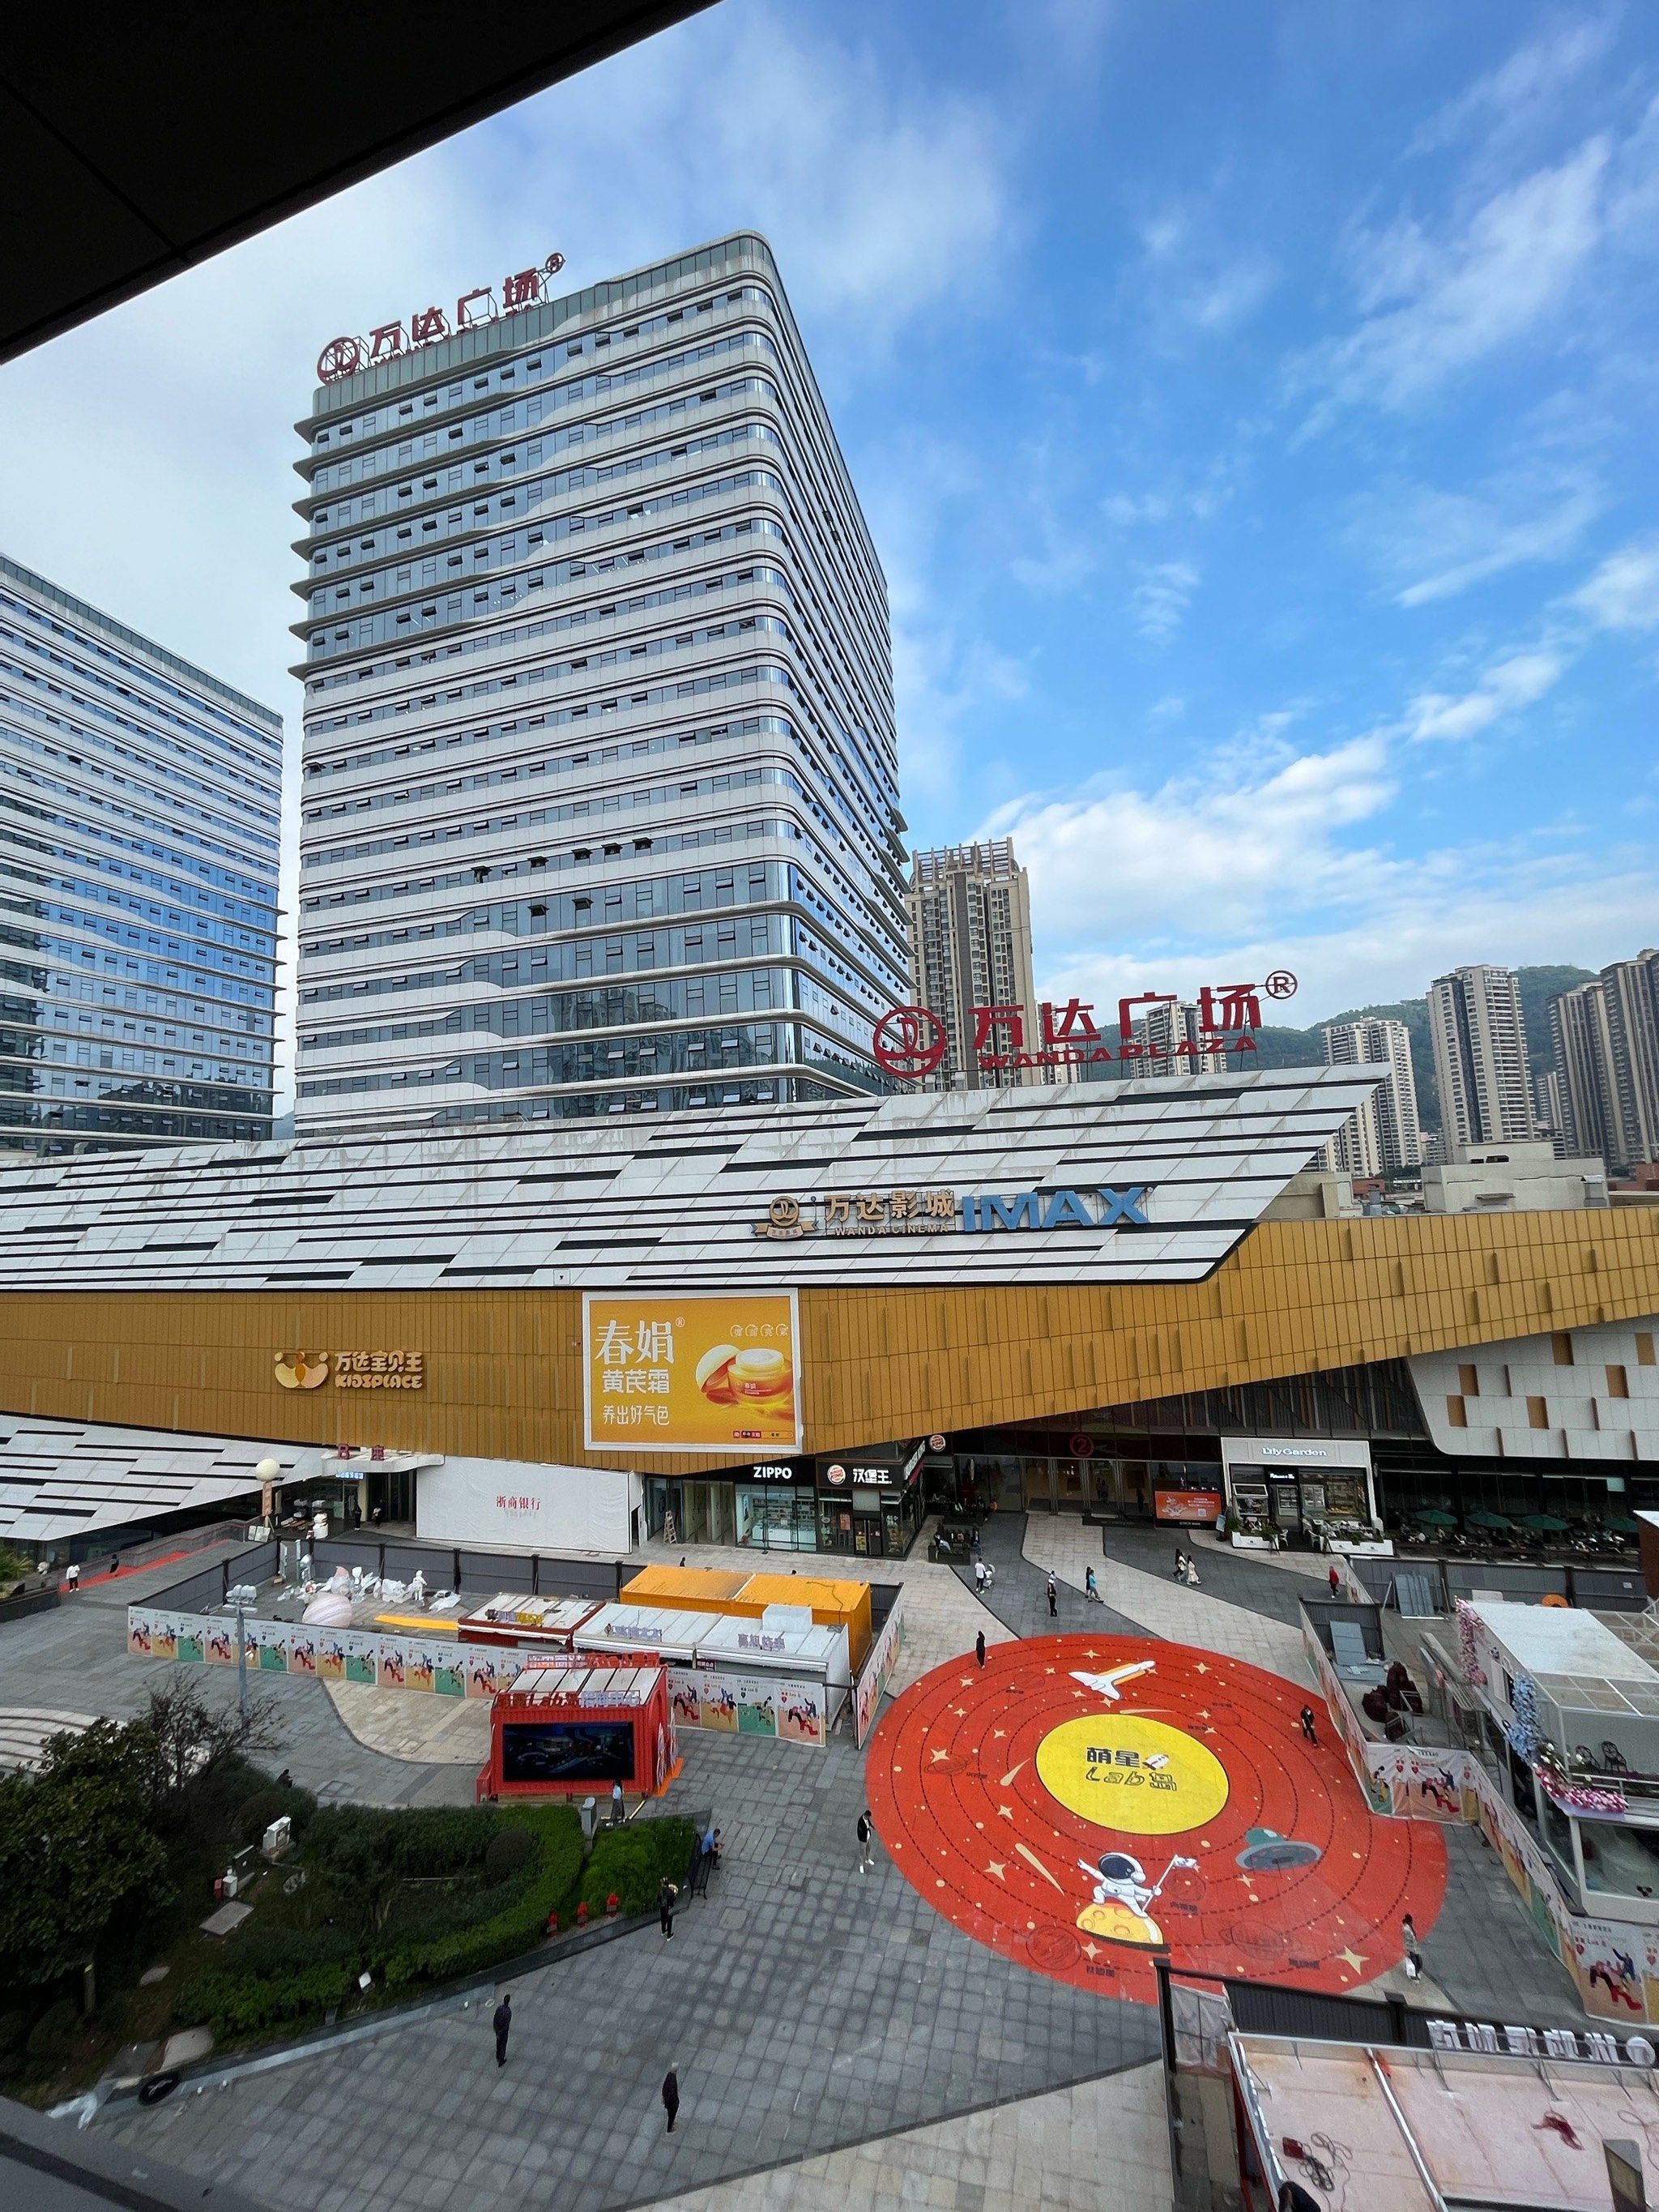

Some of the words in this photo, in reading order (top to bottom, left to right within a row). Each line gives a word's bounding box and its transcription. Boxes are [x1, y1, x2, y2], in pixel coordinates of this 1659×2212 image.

[369, 267, 539, 358] 万达广场
[969, 983, 1262, 1049] 万达广场
[977, 1048, 1112, 1070] WANDA
[1121, 1036, 1257, 1060] PLAZA
[824, 1189, 955, 1223] 万达影城
[962, 1186, 1152, 1233] IMAX
[835, 1225, 887, 1236] WANDA
[892, 1223, 949, 1234] CINEMA
[595, 1320, 674, 1364] 春娟
[335, 1350, 424, 1373] 万达宝贝王
[603, 1369, 670, 1394] 黄芪霜
[603, 1404, 670, 1426] 养出好气色
[753, 1466, 792, 1480] ZIPPO
[852, 1467, 891, 1484] 汉堡王
[497, 1495, 540, 1510] 浙商银行
[1086, 1747, 1141, 1768] 萌星
